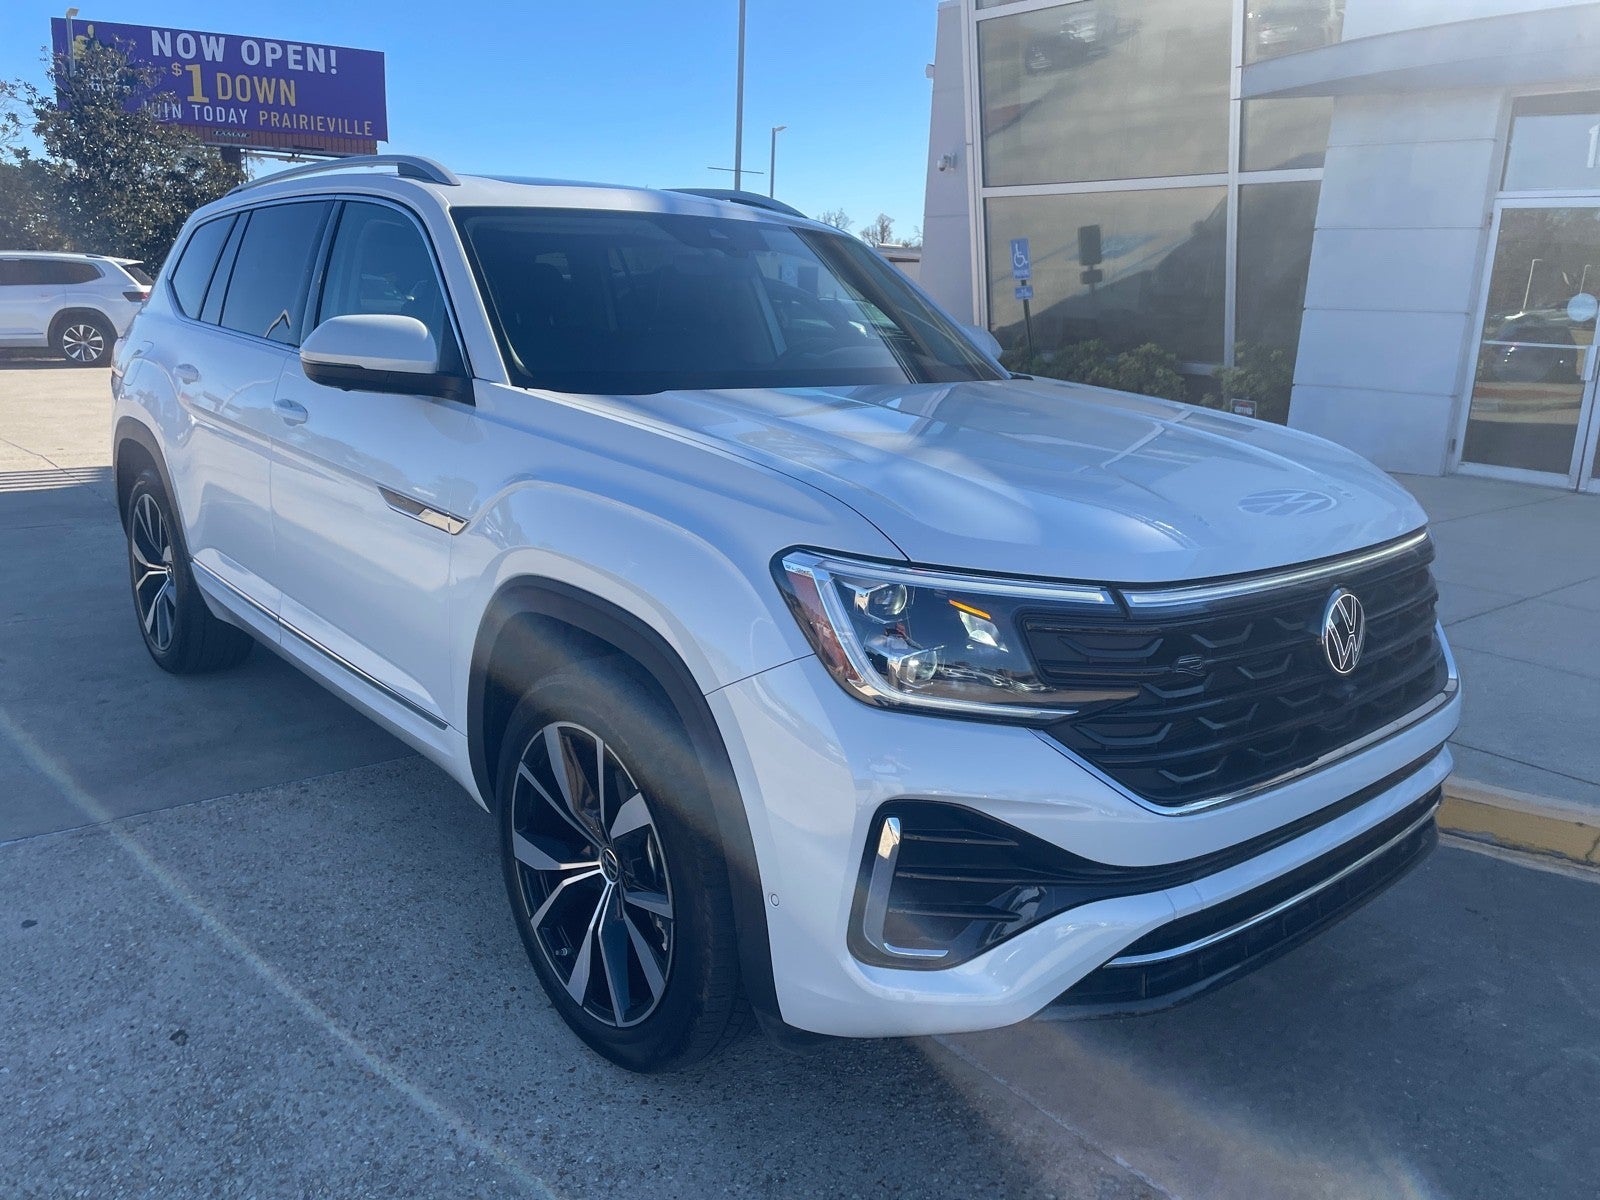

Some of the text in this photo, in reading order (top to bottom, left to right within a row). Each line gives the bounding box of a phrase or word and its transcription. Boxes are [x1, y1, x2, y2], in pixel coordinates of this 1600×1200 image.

[151, 30, 337, 75] NOW OPEN!
[216, 72, 296, 107] DOWN
[191, 104, 247, 124] TODAY
[259, 110, 373, 136] PRAIRIEVILLE
